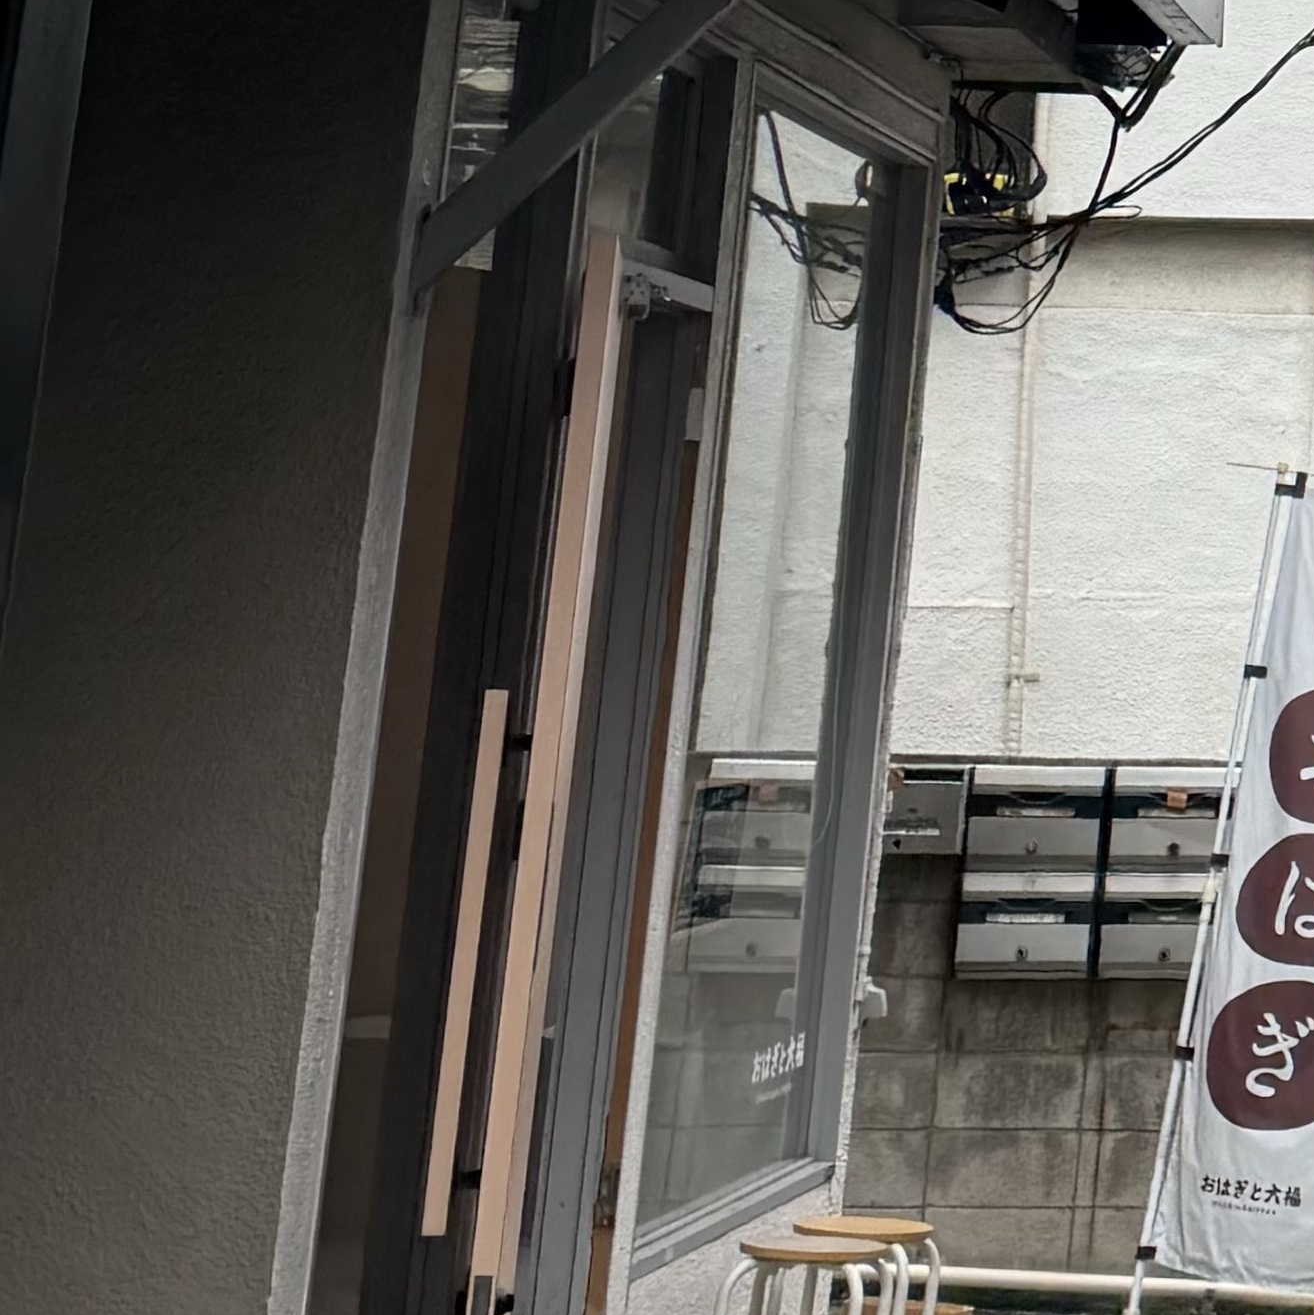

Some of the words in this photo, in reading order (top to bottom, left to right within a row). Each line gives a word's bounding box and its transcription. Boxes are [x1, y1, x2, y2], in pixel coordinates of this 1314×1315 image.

[1200, 1174, 1302, 1208] おはぎと大福
